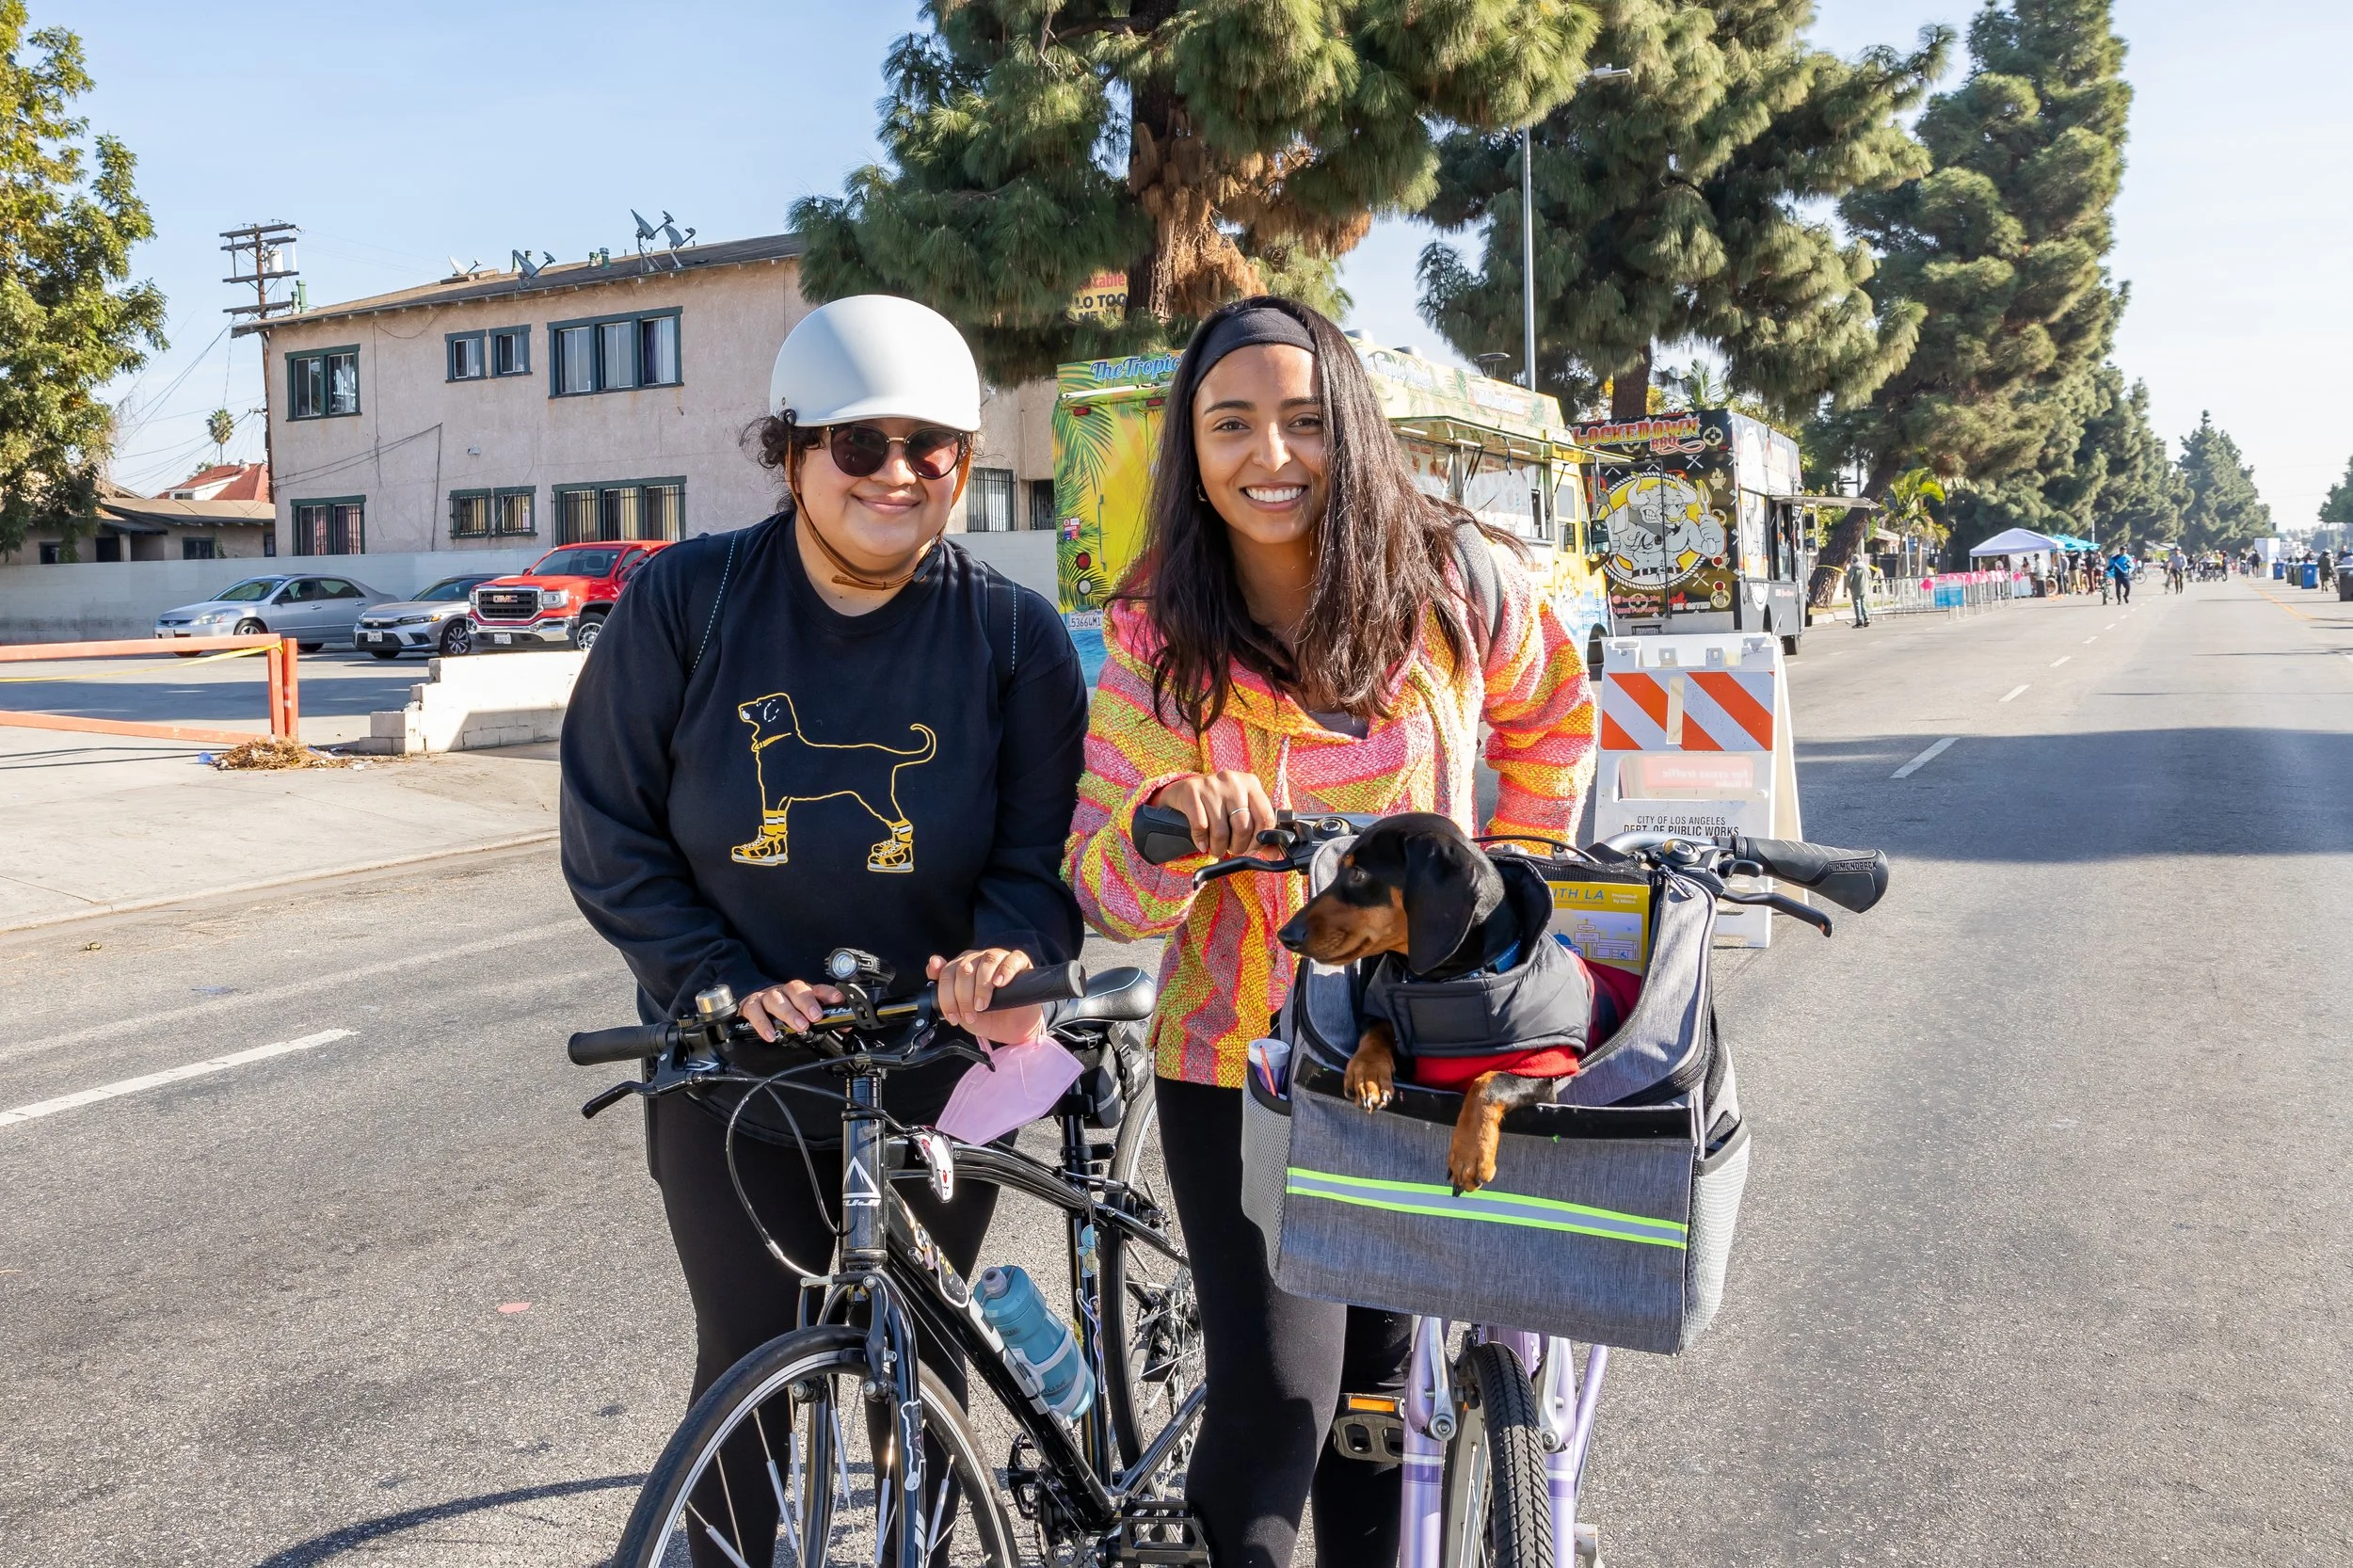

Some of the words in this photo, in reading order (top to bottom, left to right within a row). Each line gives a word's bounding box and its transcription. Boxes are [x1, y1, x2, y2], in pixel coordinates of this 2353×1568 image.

[1090, 361, 1123, 381] The
[1572, 417, 1701, 446] LOCKEDOWN
[1637, 815, 1656, 824] CITY
[1657, 816, 1668, 825] OF
[1670, 817, 1687, 825] LOS
[1689, 817, 1726, 825] ANGELES
[1668, 825, 1702, 837] PUBLIC
[1705, 826, 1739, 837] WORKS
[1829, 861, 1877, 872] DIAMONDBACK
[1584, 888, 1605, 900] LA
